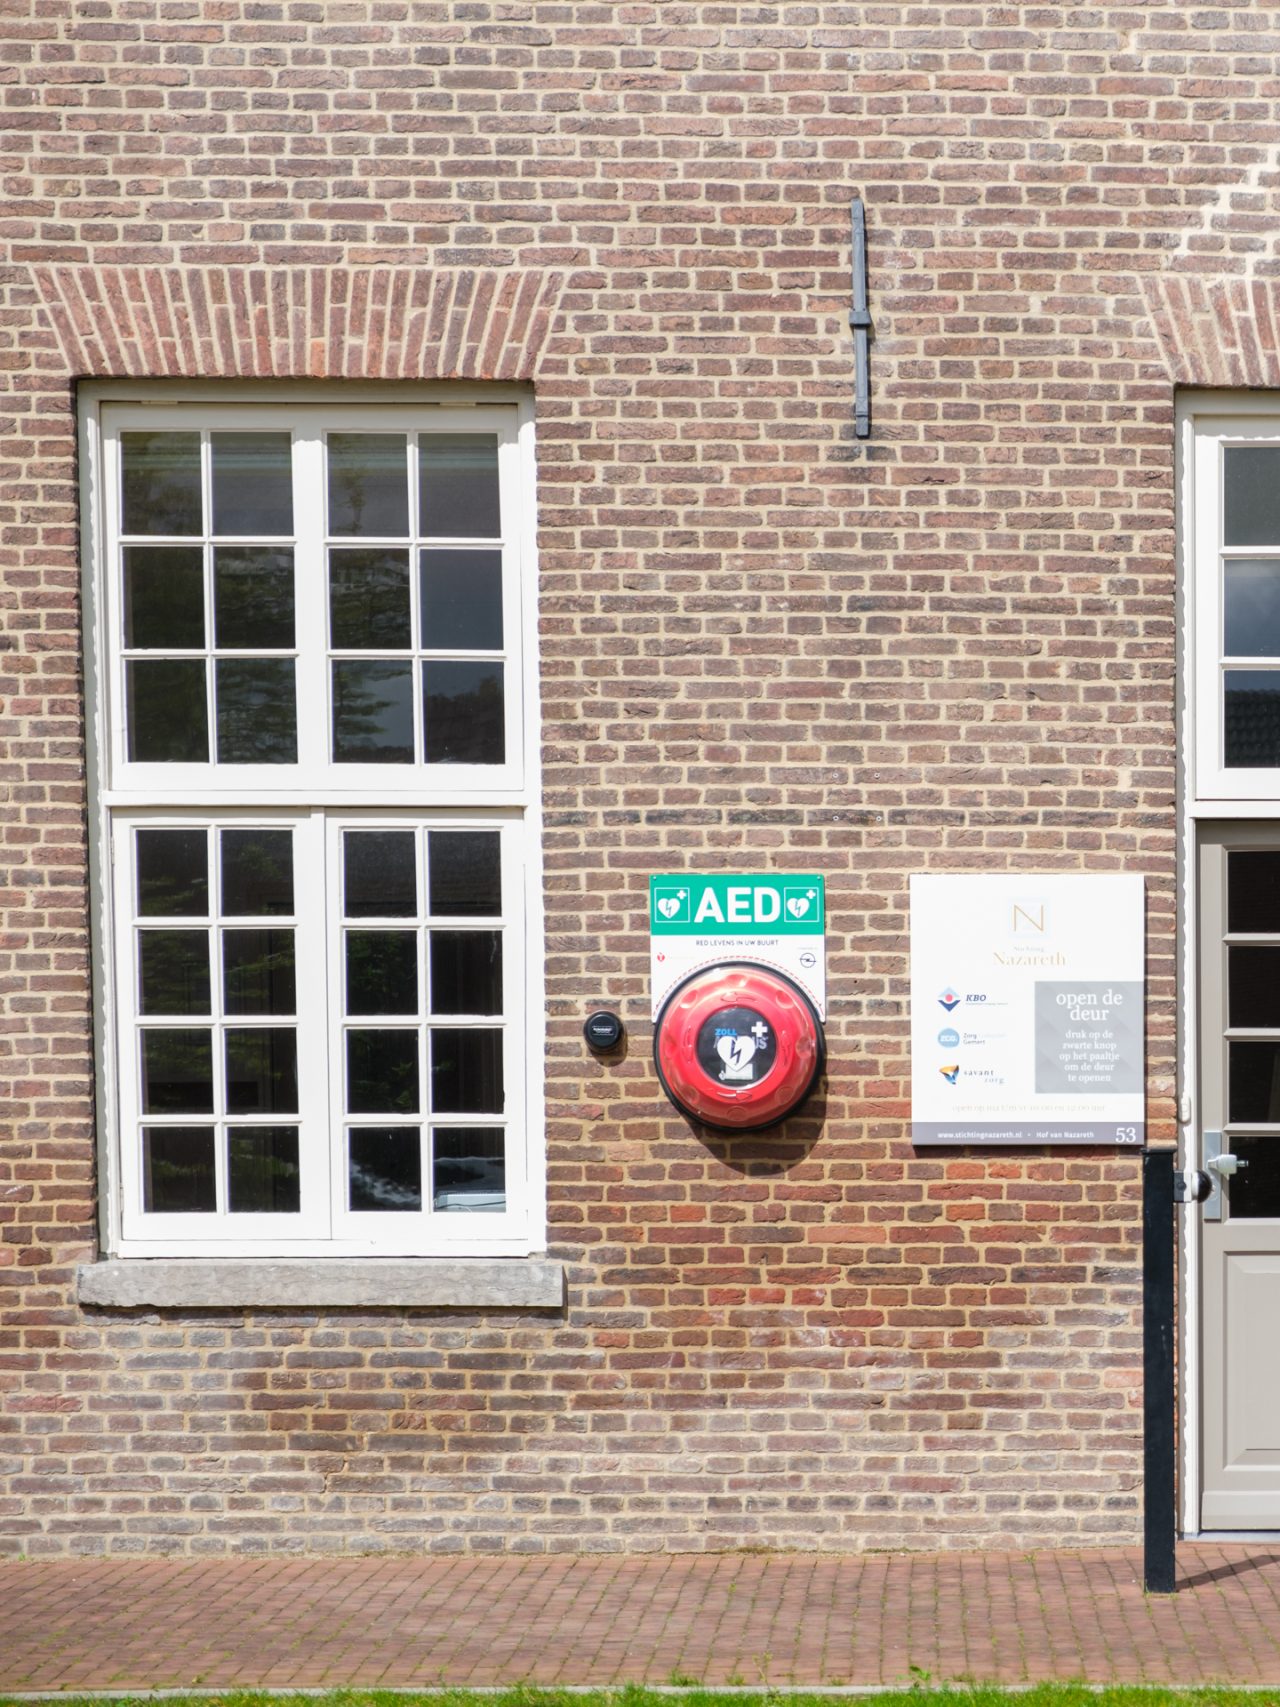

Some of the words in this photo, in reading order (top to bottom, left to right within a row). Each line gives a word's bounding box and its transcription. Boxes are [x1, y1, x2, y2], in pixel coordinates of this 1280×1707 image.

[693, 887, 781, 923] AED
[1013, 904, 1044, 932] N
[993, 951, 1066, 966] Nazareth
[966, 994, 987, 1002] KBO
[1056, 993, 1098, 1009] open
[1102, 989, 1123, 1005] de
[1070, 1004, 1109, 1021] deur
[714, 1028, 738, 1036] ZOLL
[1065, 1029, 1087, 1039] druk
[1088, 1031, 1101, 1041] op
[1102, 1029, 1114, 1039] de
[1062, 1042, 1093, 1050] zwarte
[1094, 1040, 1117, 1051] knop
[1059, 1053, 1071, 1062] op
[1073, 1051, 1088, 1060] het
[1089, 1051, 1120, 1062] paaltje
[1080, 1062, 1092, 1071] de
[1093, 1062, 1115, 1071] deur
[1067, 1074, 1077, 1082] te
[1078, 1074, 1112, 1084] openen
[937, 1131, 1023, 1140] www.stichtingnazareth.nl
[1115, 1127, 1137, 1143] 53
